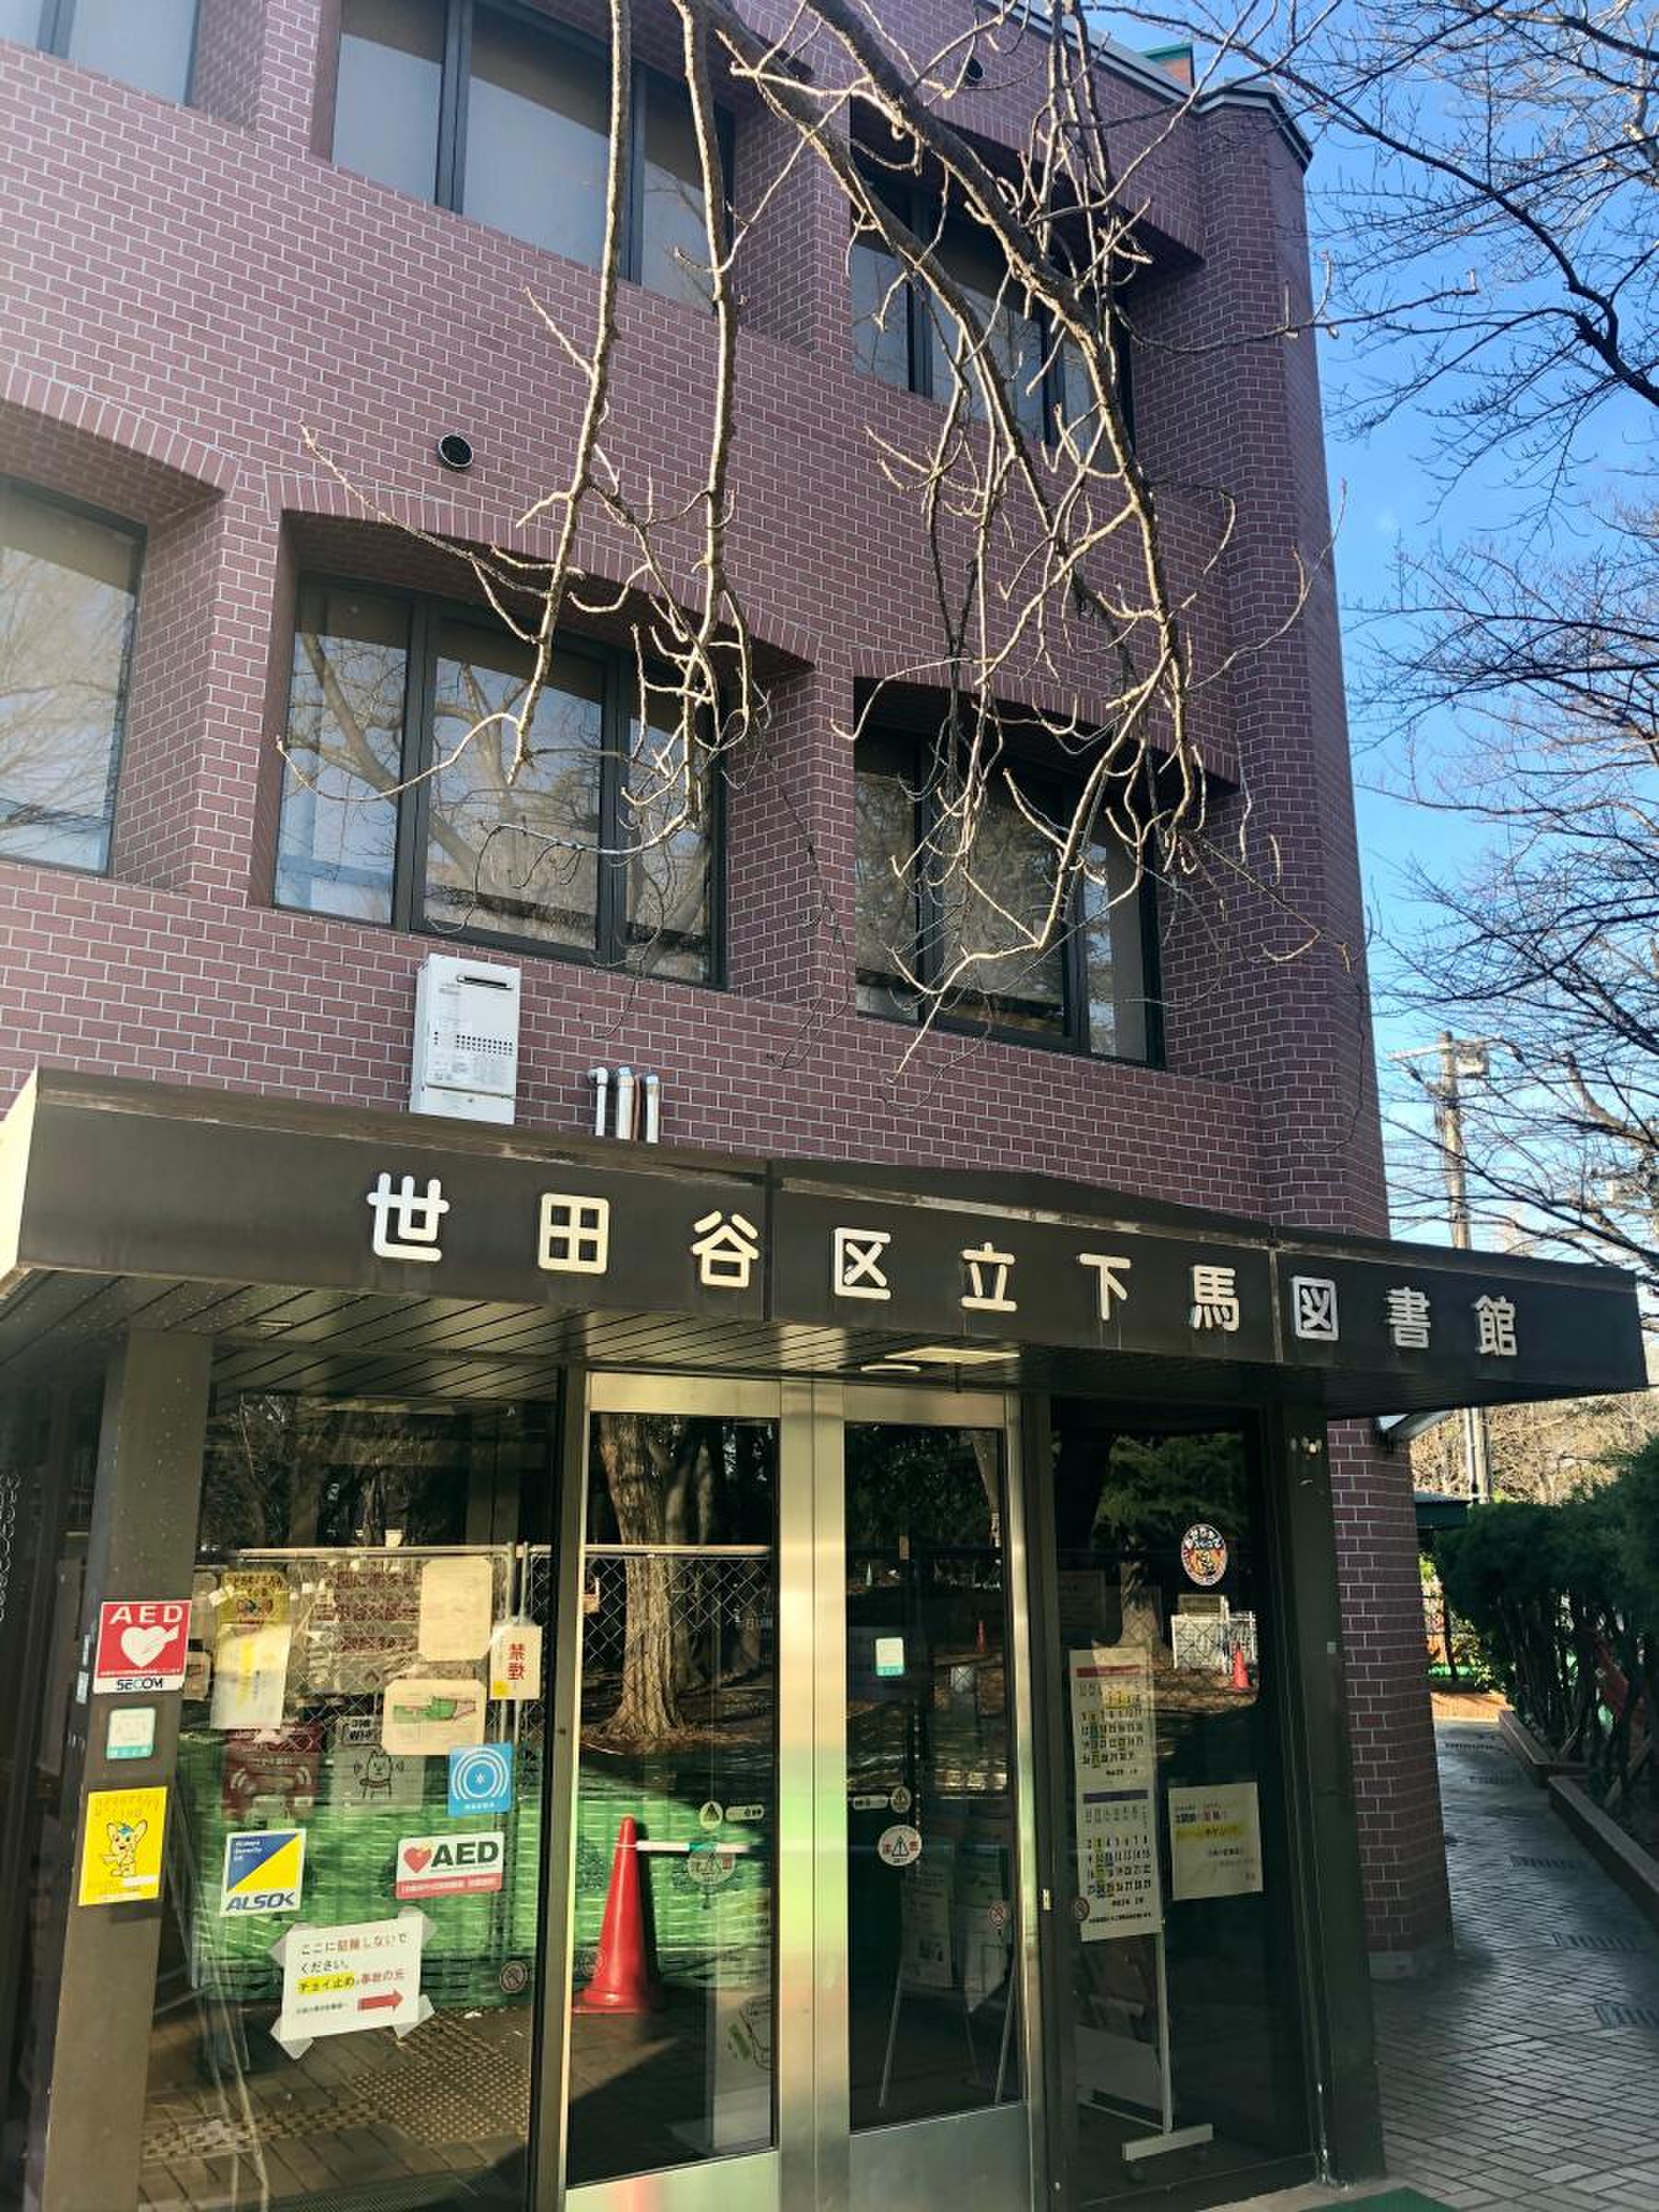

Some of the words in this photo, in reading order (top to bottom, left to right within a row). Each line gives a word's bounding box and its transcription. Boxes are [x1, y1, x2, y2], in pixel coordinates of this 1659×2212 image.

[366, 1172, 1519, 1357] 世田谷区立下馬図書館
[109, 1605, 183, 1625] AED
[117, 1677, 164, 1690] SECOM
[430, 1841, 500, 1868] AED
[226, 1892, 296, 1912] ALSOK
